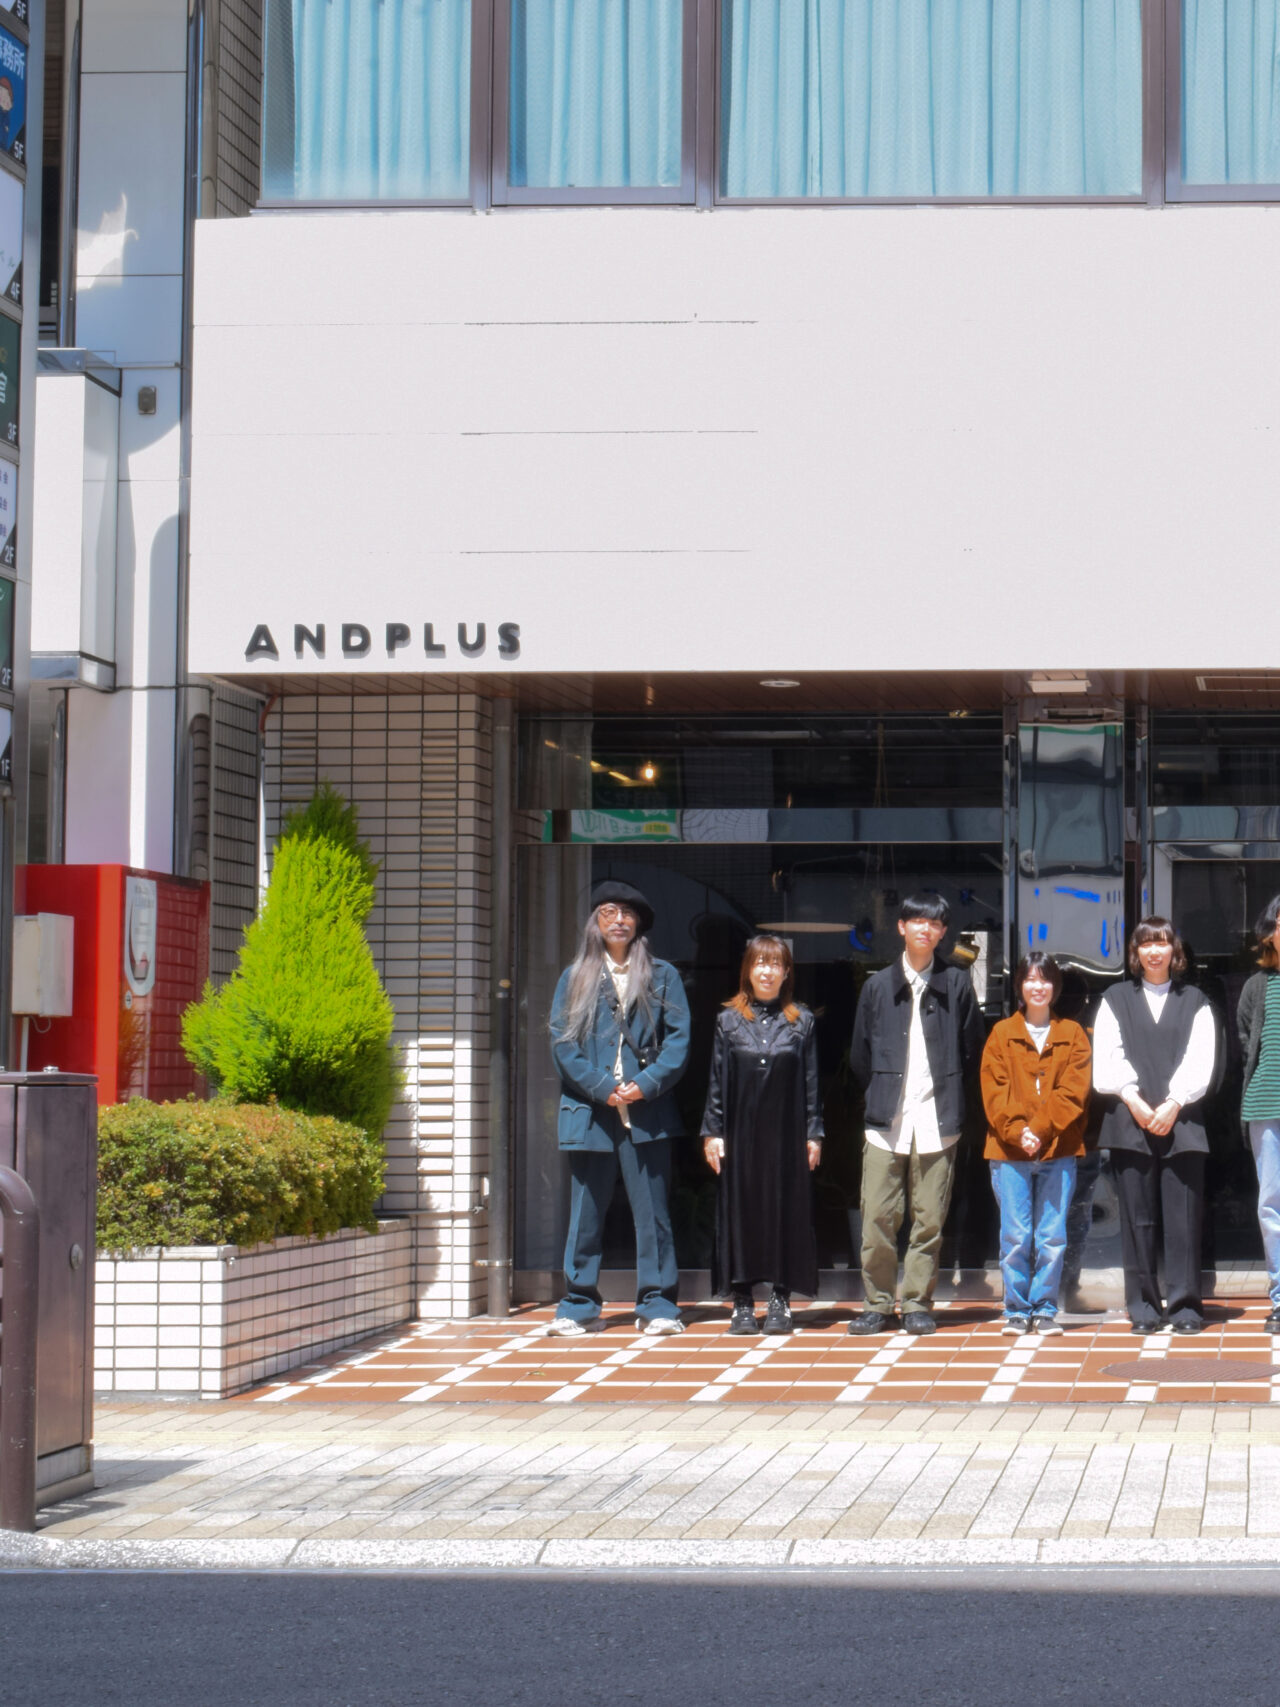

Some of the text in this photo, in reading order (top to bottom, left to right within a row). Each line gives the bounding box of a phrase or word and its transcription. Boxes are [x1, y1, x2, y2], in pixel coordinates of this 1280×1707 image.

[0, 35, 25, 80] 務所
[14, 141, 24, 160] 5F
[10, 281, 20, 300] 4F
[7, 422, 17, 440] 3F
[4, 545, 14, 564] 2F
[244, 622, 521, 658] ANDPLUS
[1, 667, 11, 685] 2F
[1, 759, 10, 776] 1F
